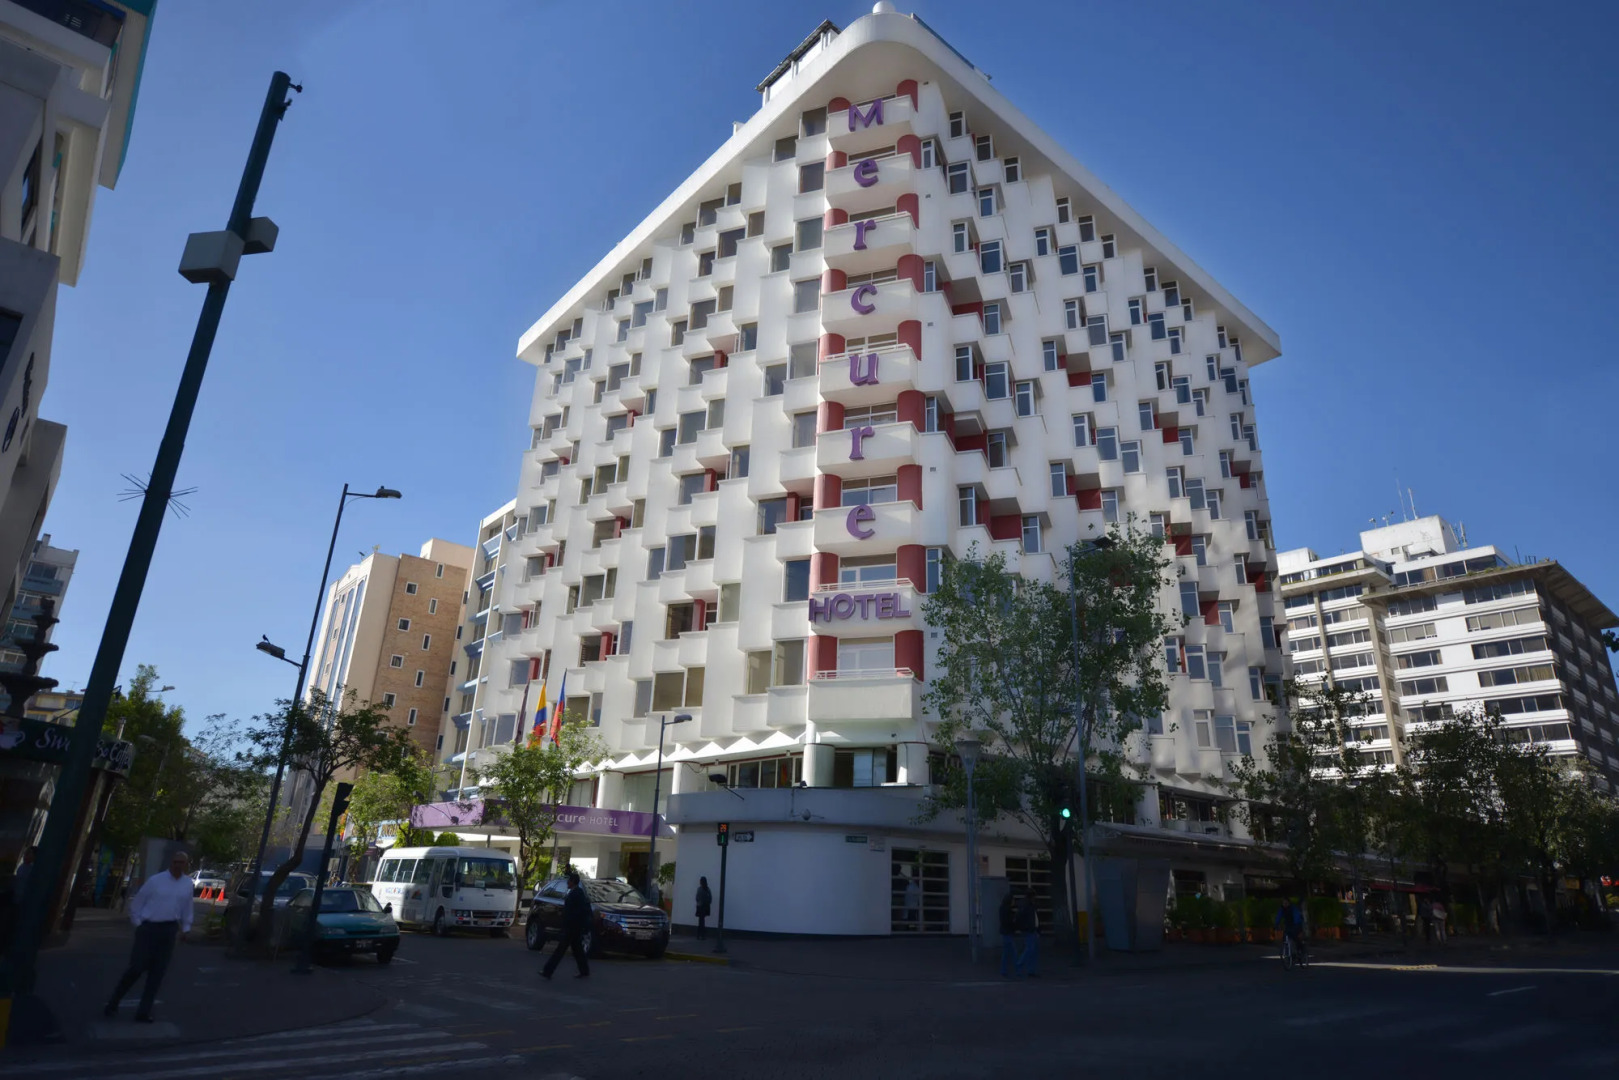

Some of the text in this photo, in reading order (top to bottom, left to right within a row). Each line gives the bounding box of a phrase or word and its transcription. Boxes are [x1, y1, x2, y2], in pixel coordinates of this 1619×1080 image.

[846, 98, 884, 540] Mercure
[808, 592, 911, 623] HOTEL
[589, 816, 618, 827] HOTEL
